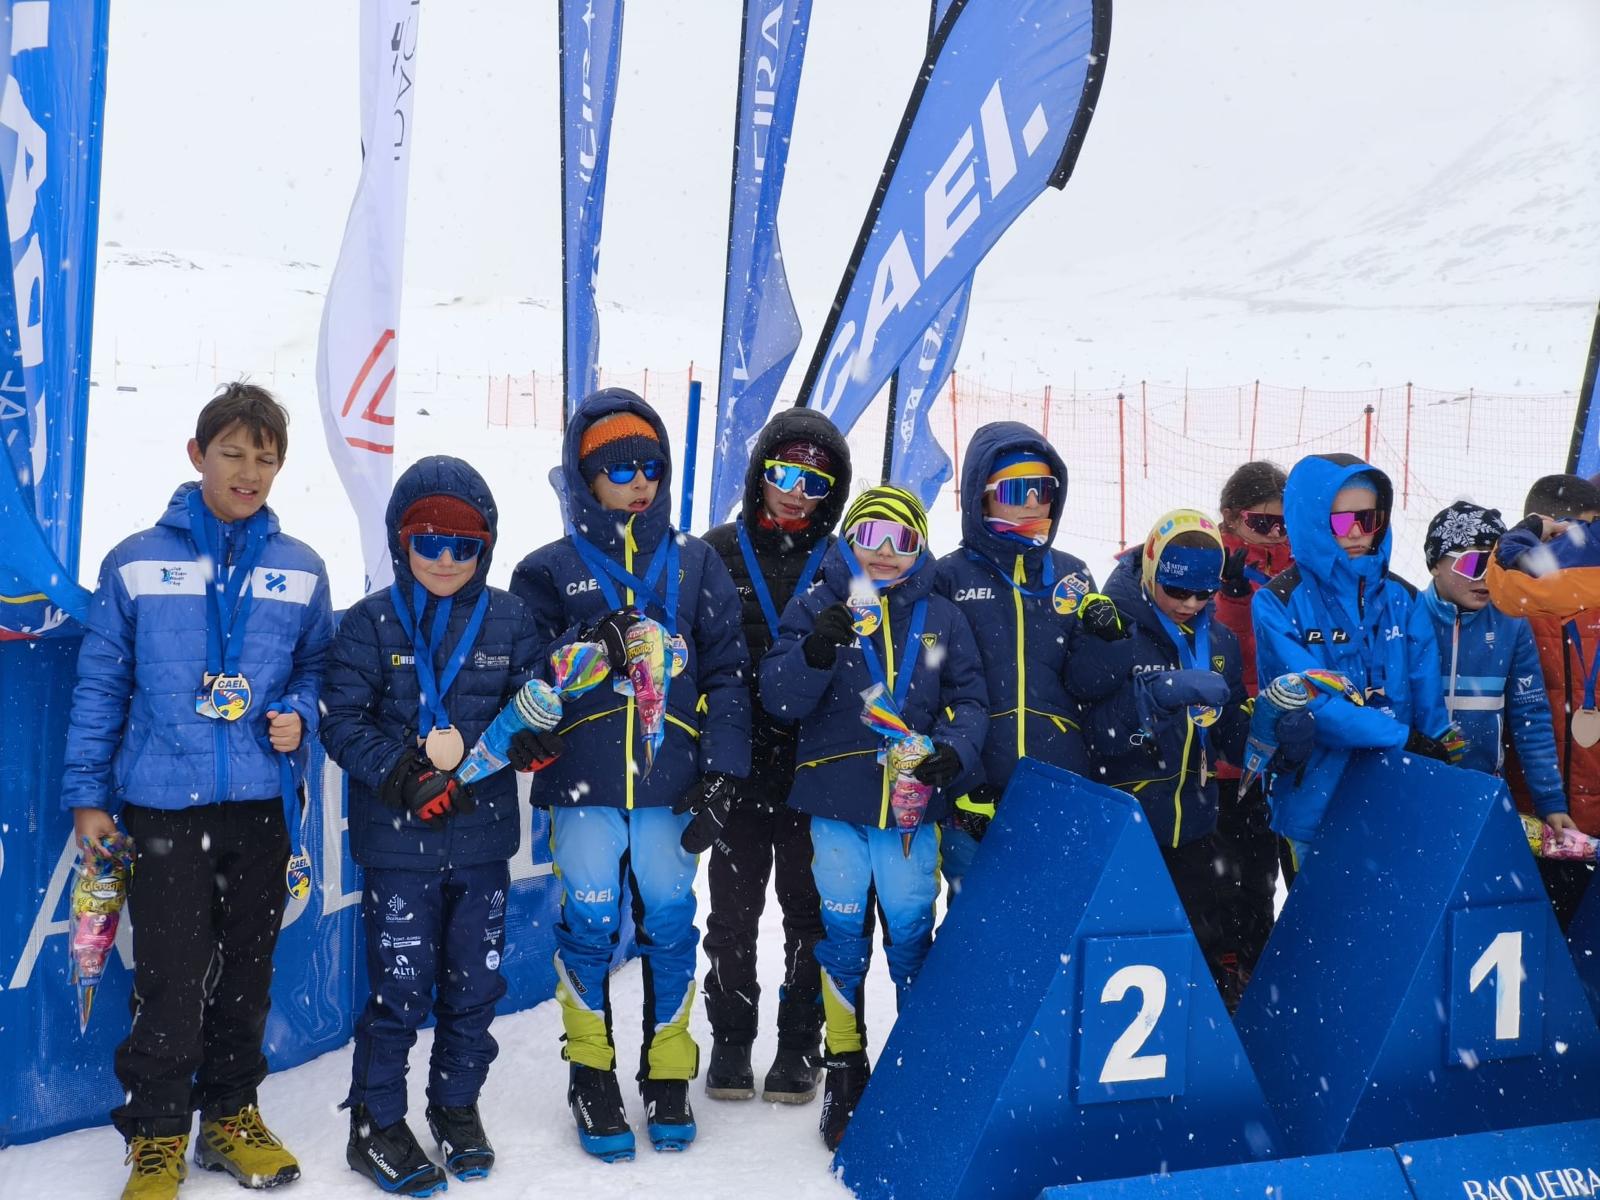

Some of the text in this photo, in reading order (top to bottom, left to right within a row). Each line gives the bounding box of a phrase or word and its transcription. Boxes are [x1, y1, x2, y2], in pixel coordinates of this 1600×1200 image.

[811, 77, 1049, 414] CAEI.
[566, 578, 601, 596] CAE
[955, 587, 995, 602] CAEI.
[217, 680, 245, 689] CAEI.
[704, 776, 725, 799] LEKI
[574, 887, 615, 904] CAEI.
[823, 899, 862, 914] CAEI.
[392, 966, 415, 977] ALTI
[1469, 931, 1523, 1040] 1
[1098, 964, 1168, 1084] 2
[577, 1095, 594, 1129] SALOMON
[367, 1147, 399, 1179] SALOMON
